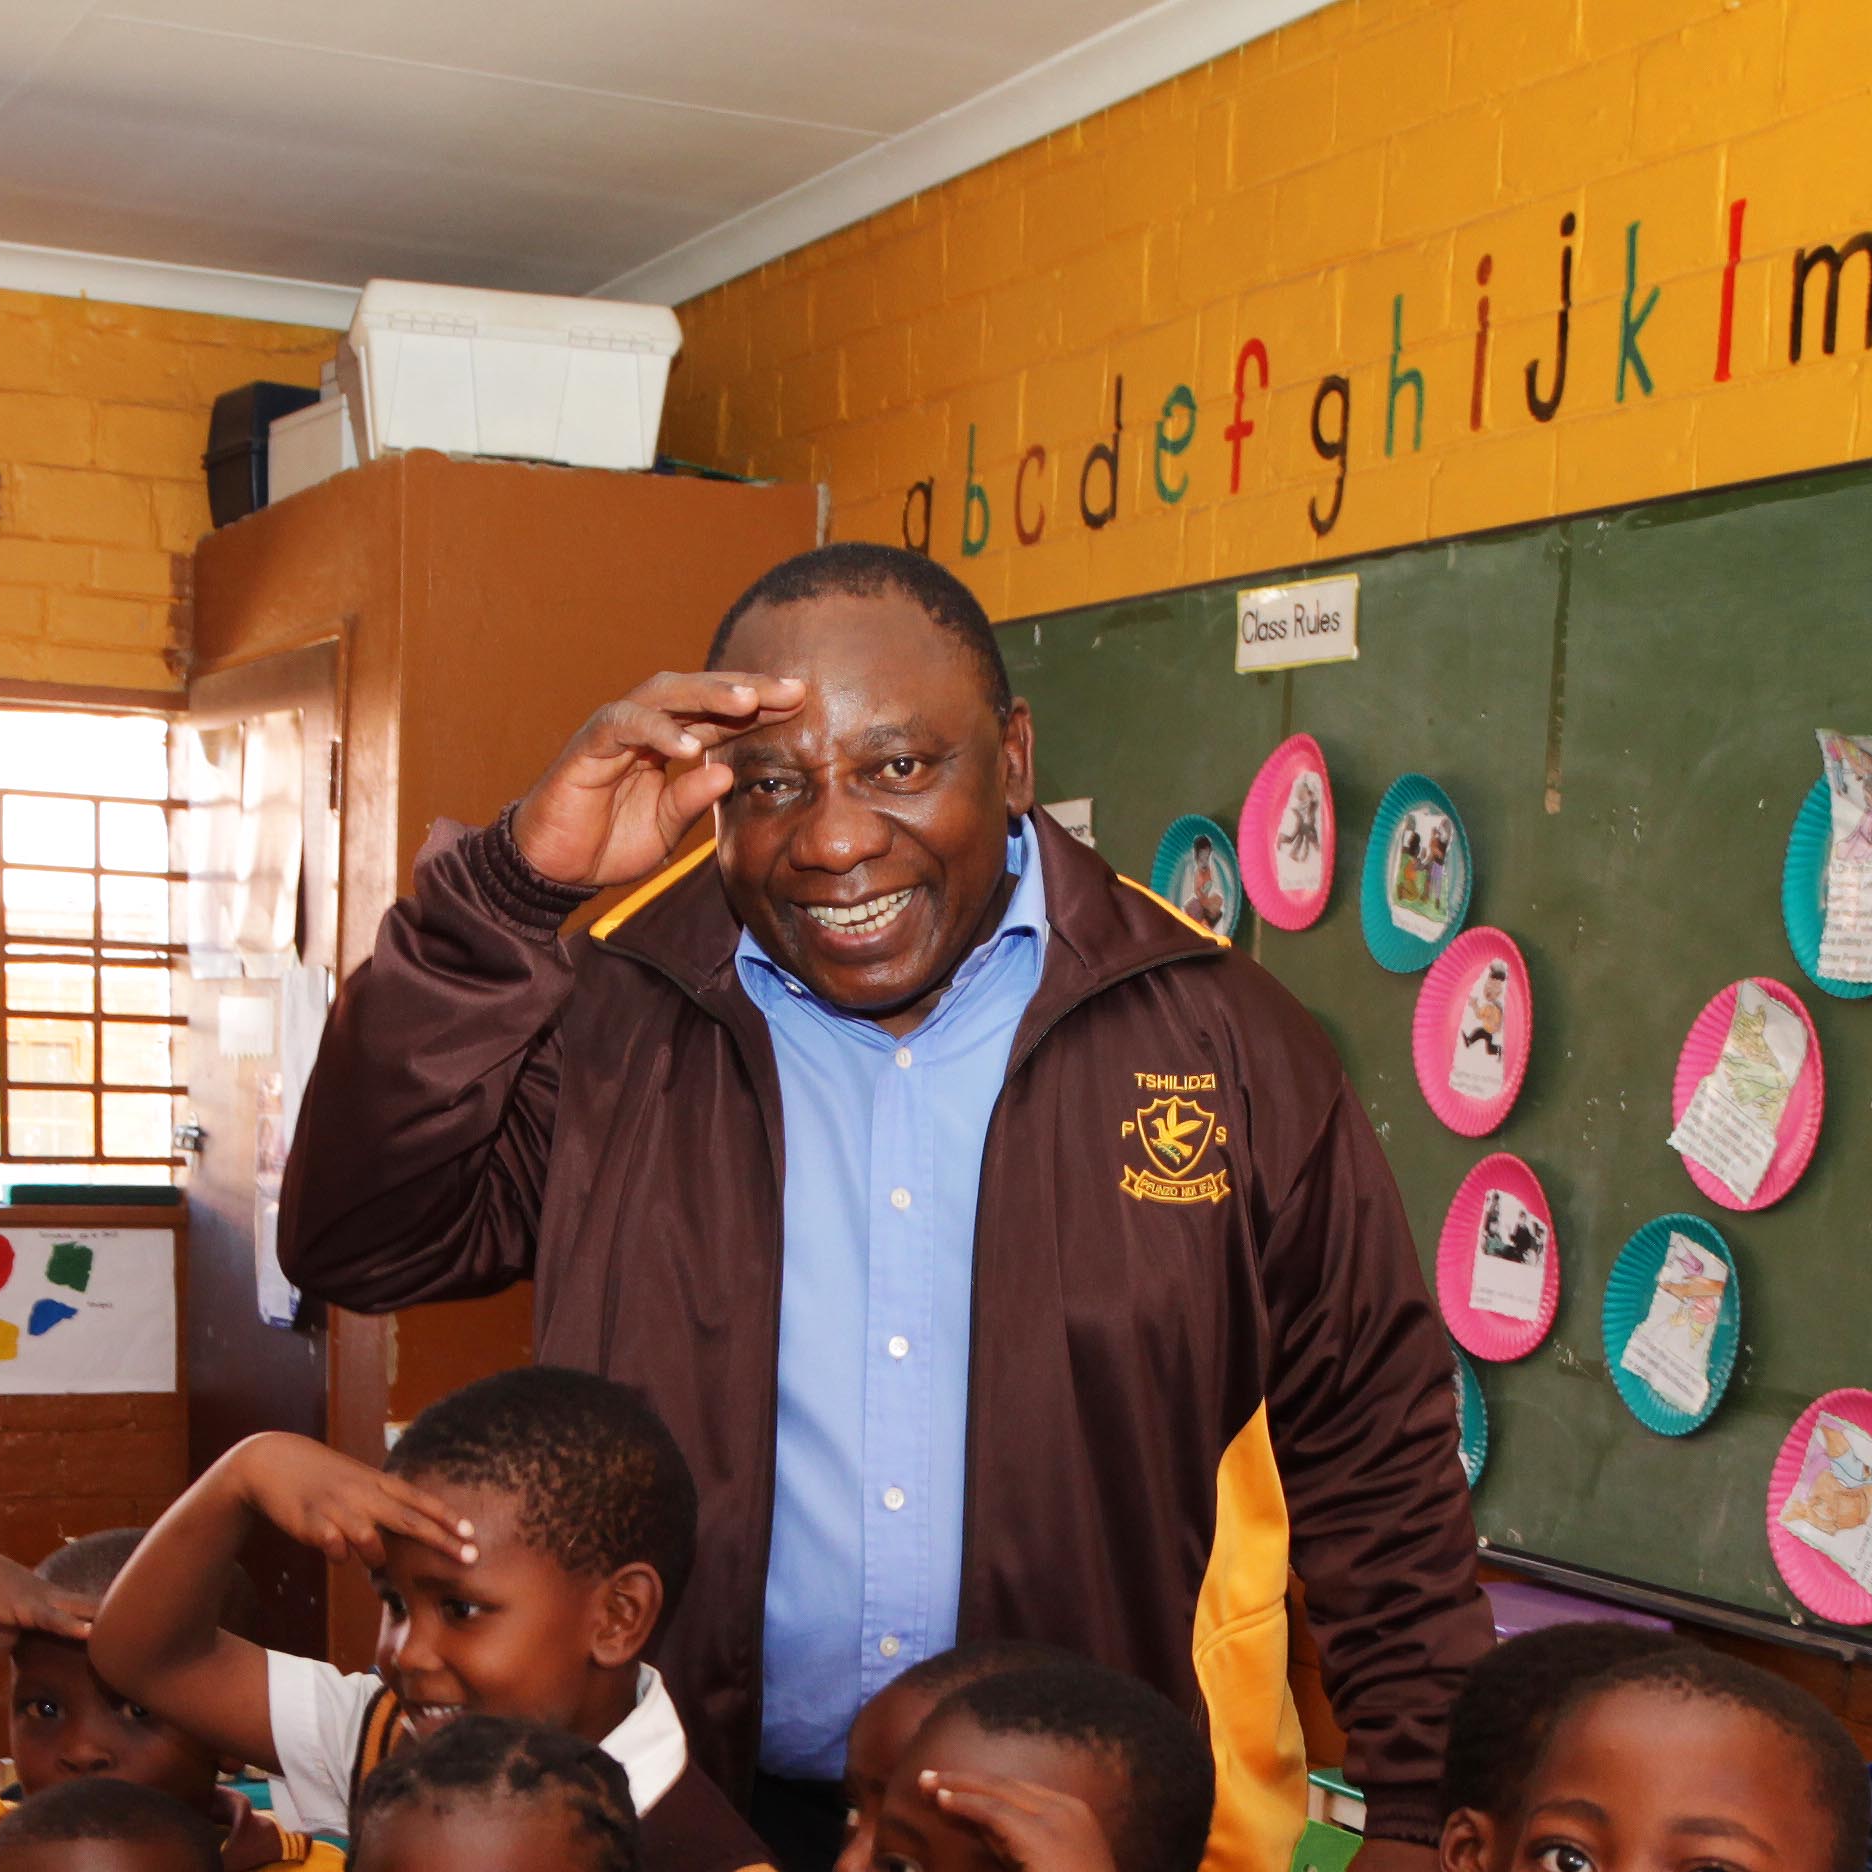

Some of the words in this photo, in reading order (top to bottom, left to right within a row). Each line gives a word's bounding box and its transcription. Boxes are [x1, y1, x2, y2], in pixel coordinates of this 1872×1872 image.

[961, 423, 990, 557] b
[1015, 444, 1046, 546] c
[1080, 373, 1123, 530] d
[1154, 384, 1198, 504] e
[1224, 338, 1269, 494] f
[1308, 373, 1352, 538] g
[1384, 295, 1425, 457] h
[1470, 253, 1494, 432] i
[1524, 211, 1577, 423] j
[1615, 220, 1661, 403] k
[1713, 199, 1747, 383] l
[1242, 608, 1288, 644] Class
[1293, 600, 1341, 639] Rules
[1134, 1072, 1217, 1091] TSHILIDZI
[1122, 1121, 1136, 1138] P
[1215, 1126, 1227, 1145] S
